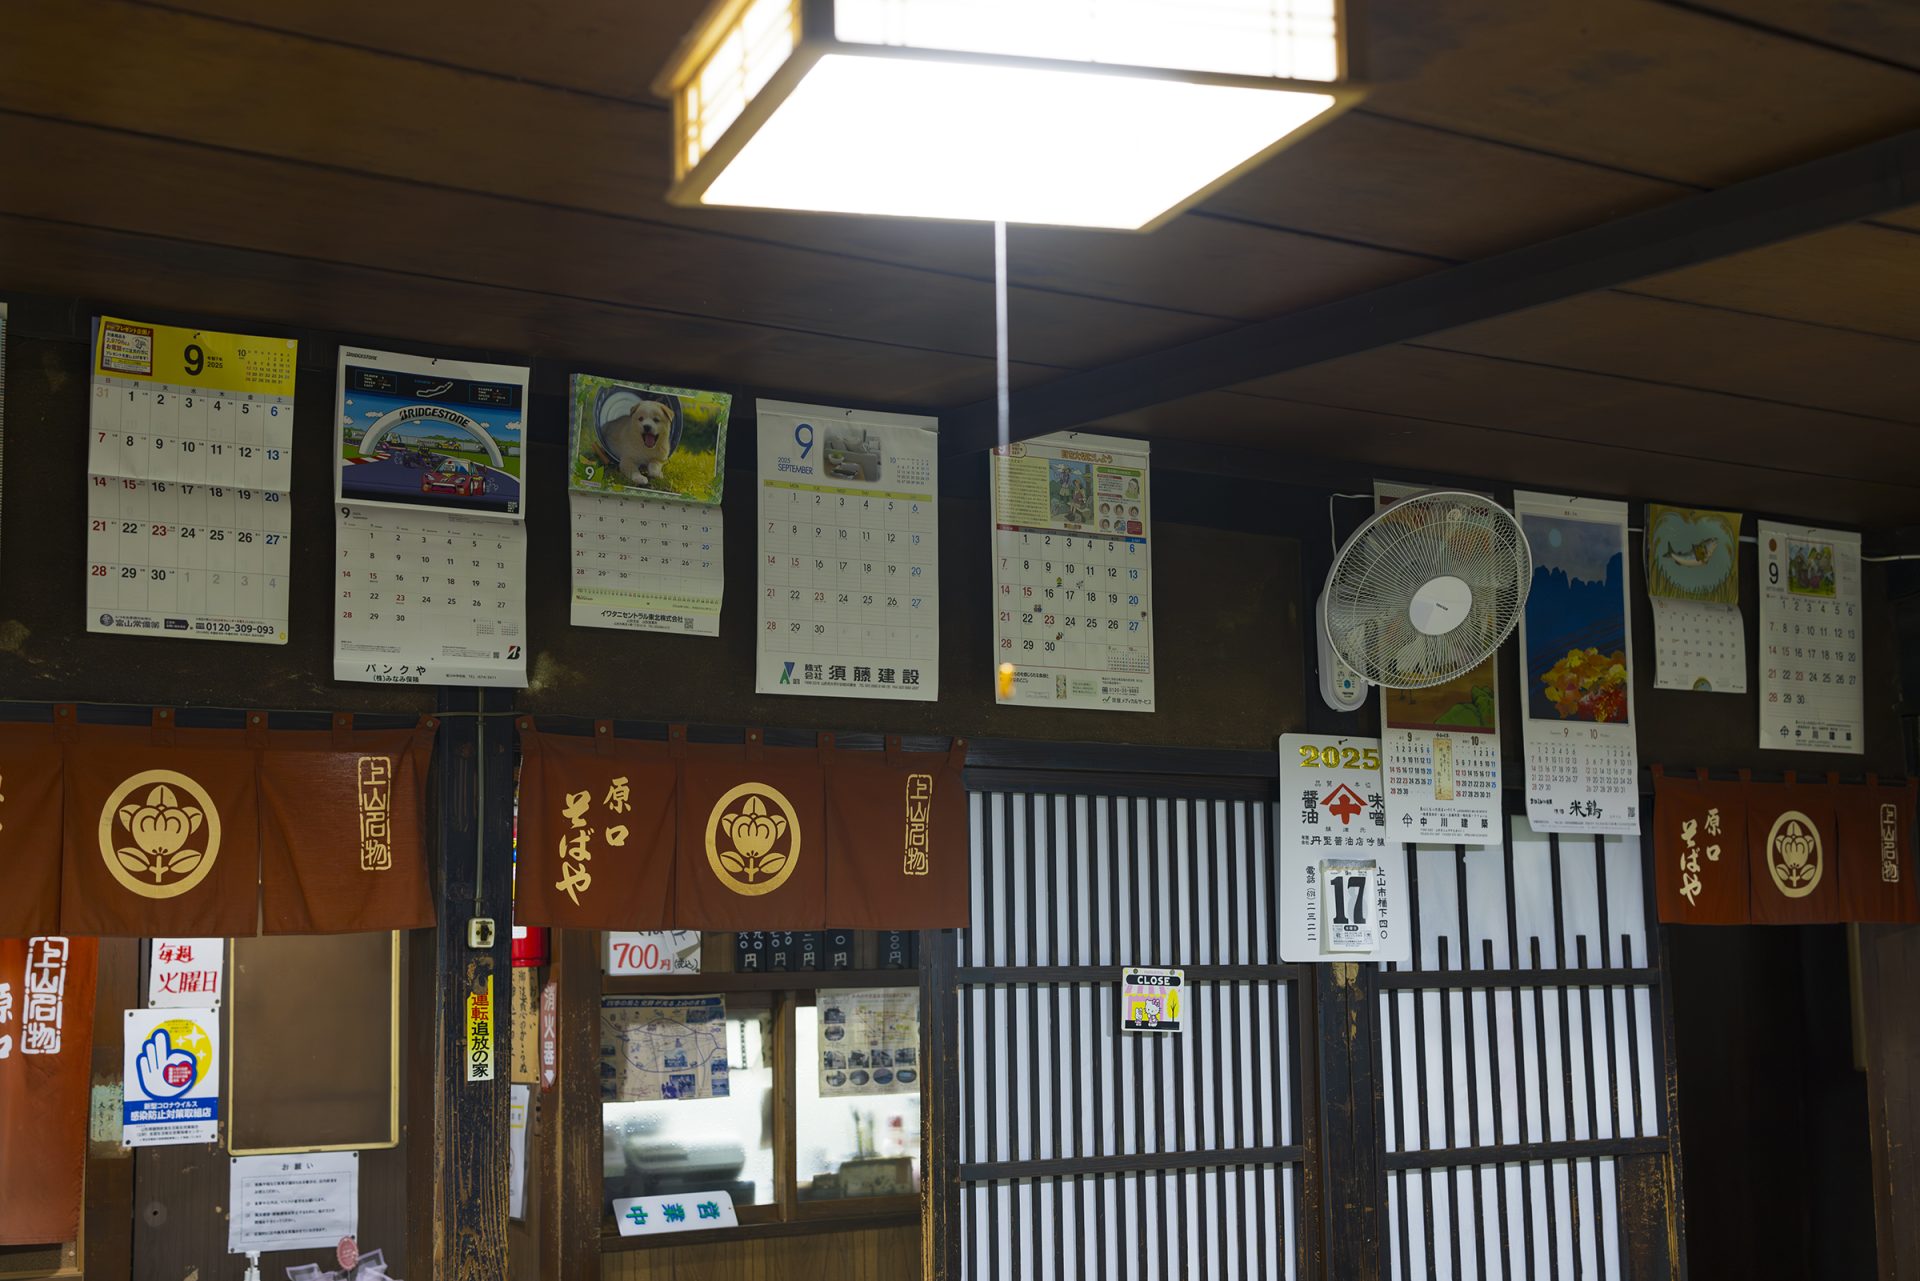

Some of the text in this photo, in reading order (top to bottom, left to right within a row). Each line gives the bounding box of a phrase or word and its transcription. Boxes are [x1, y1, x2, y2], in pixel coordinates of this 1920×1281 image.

[184, 344, 204, 376] 9
[238, 349, 247, 357] 10
[346, 352, 377, 360] BRIDGESTONE
[207, 361, 223, 369] 2025
[96, 387, 278, 416] 31 1 2 3 4 5 6
[399, 407, 470, 428] BRIDGESTONE
[99, 432, 279, 460] 7 8 9 10 11 12 13
[795, 423, 814, 459] 9
[585, 466, 595, 480] 9
[778, 463, 813, 475] SEPTEMBER
[93, 477, 279, 502] 14 15 16 17 18 19 20
[341, 507, 350, 518] 9
[93, 520, 280, 544] 21 22 23 24 25 26 27
[1024, 534, 1135, 552] 1 2 3 4 5 6
[92, 565, 276, 588] 28 29 30 1 2 3 4
[1002, 559, 1137, 579] 7 8 9 10 11 12 13
[1769, 562, 1779, 584] 9
[767, 588, 921, 608] 21 22 23 24 25 26 27
[1001, 585, 1138, 604] 14 15 16 17 18 19 20
[600, 610, 683, 623] イワタニセントラル東北株式会社
[1000, 612, 1138, 631] 21 22 23 24 25 26 27
[206, 623, 274, 634] 0120-309-093
[1001, 639, 1055, 651] 28 29 30
[828, 665, 920, 684] 須藤建設
[1407, 732, 1412, 742] 9
[1471, 736, 1479, 746] 10
[1590, 728, 1598, 740] 10
[1299, 745, 1381, 771] 2025
[604, 776, 632, 847] 原口
[1368, 793, 1384, 826] 味噌
[1420, 817, 1488, 828] 中川建築
[1704, 808, 1722, 861] 原口
[555, 790, 594, 907] そばや
[1680, 818, 1702, 907] そばや
[1330, 876, 1366, 924] 17
[160, 943, 194, 963] 毎週
[614, 944, 670, 970] 700円
[158, 970, 218, 994] 火曜日
[1137, 976, 1170, 986] CLOSE
[544, 985, 554, 1065] 消火器
[471, 993, 490, 1078] 運転追放の家
[144, 1100, 198, 1110] 新型コロナウイルス
